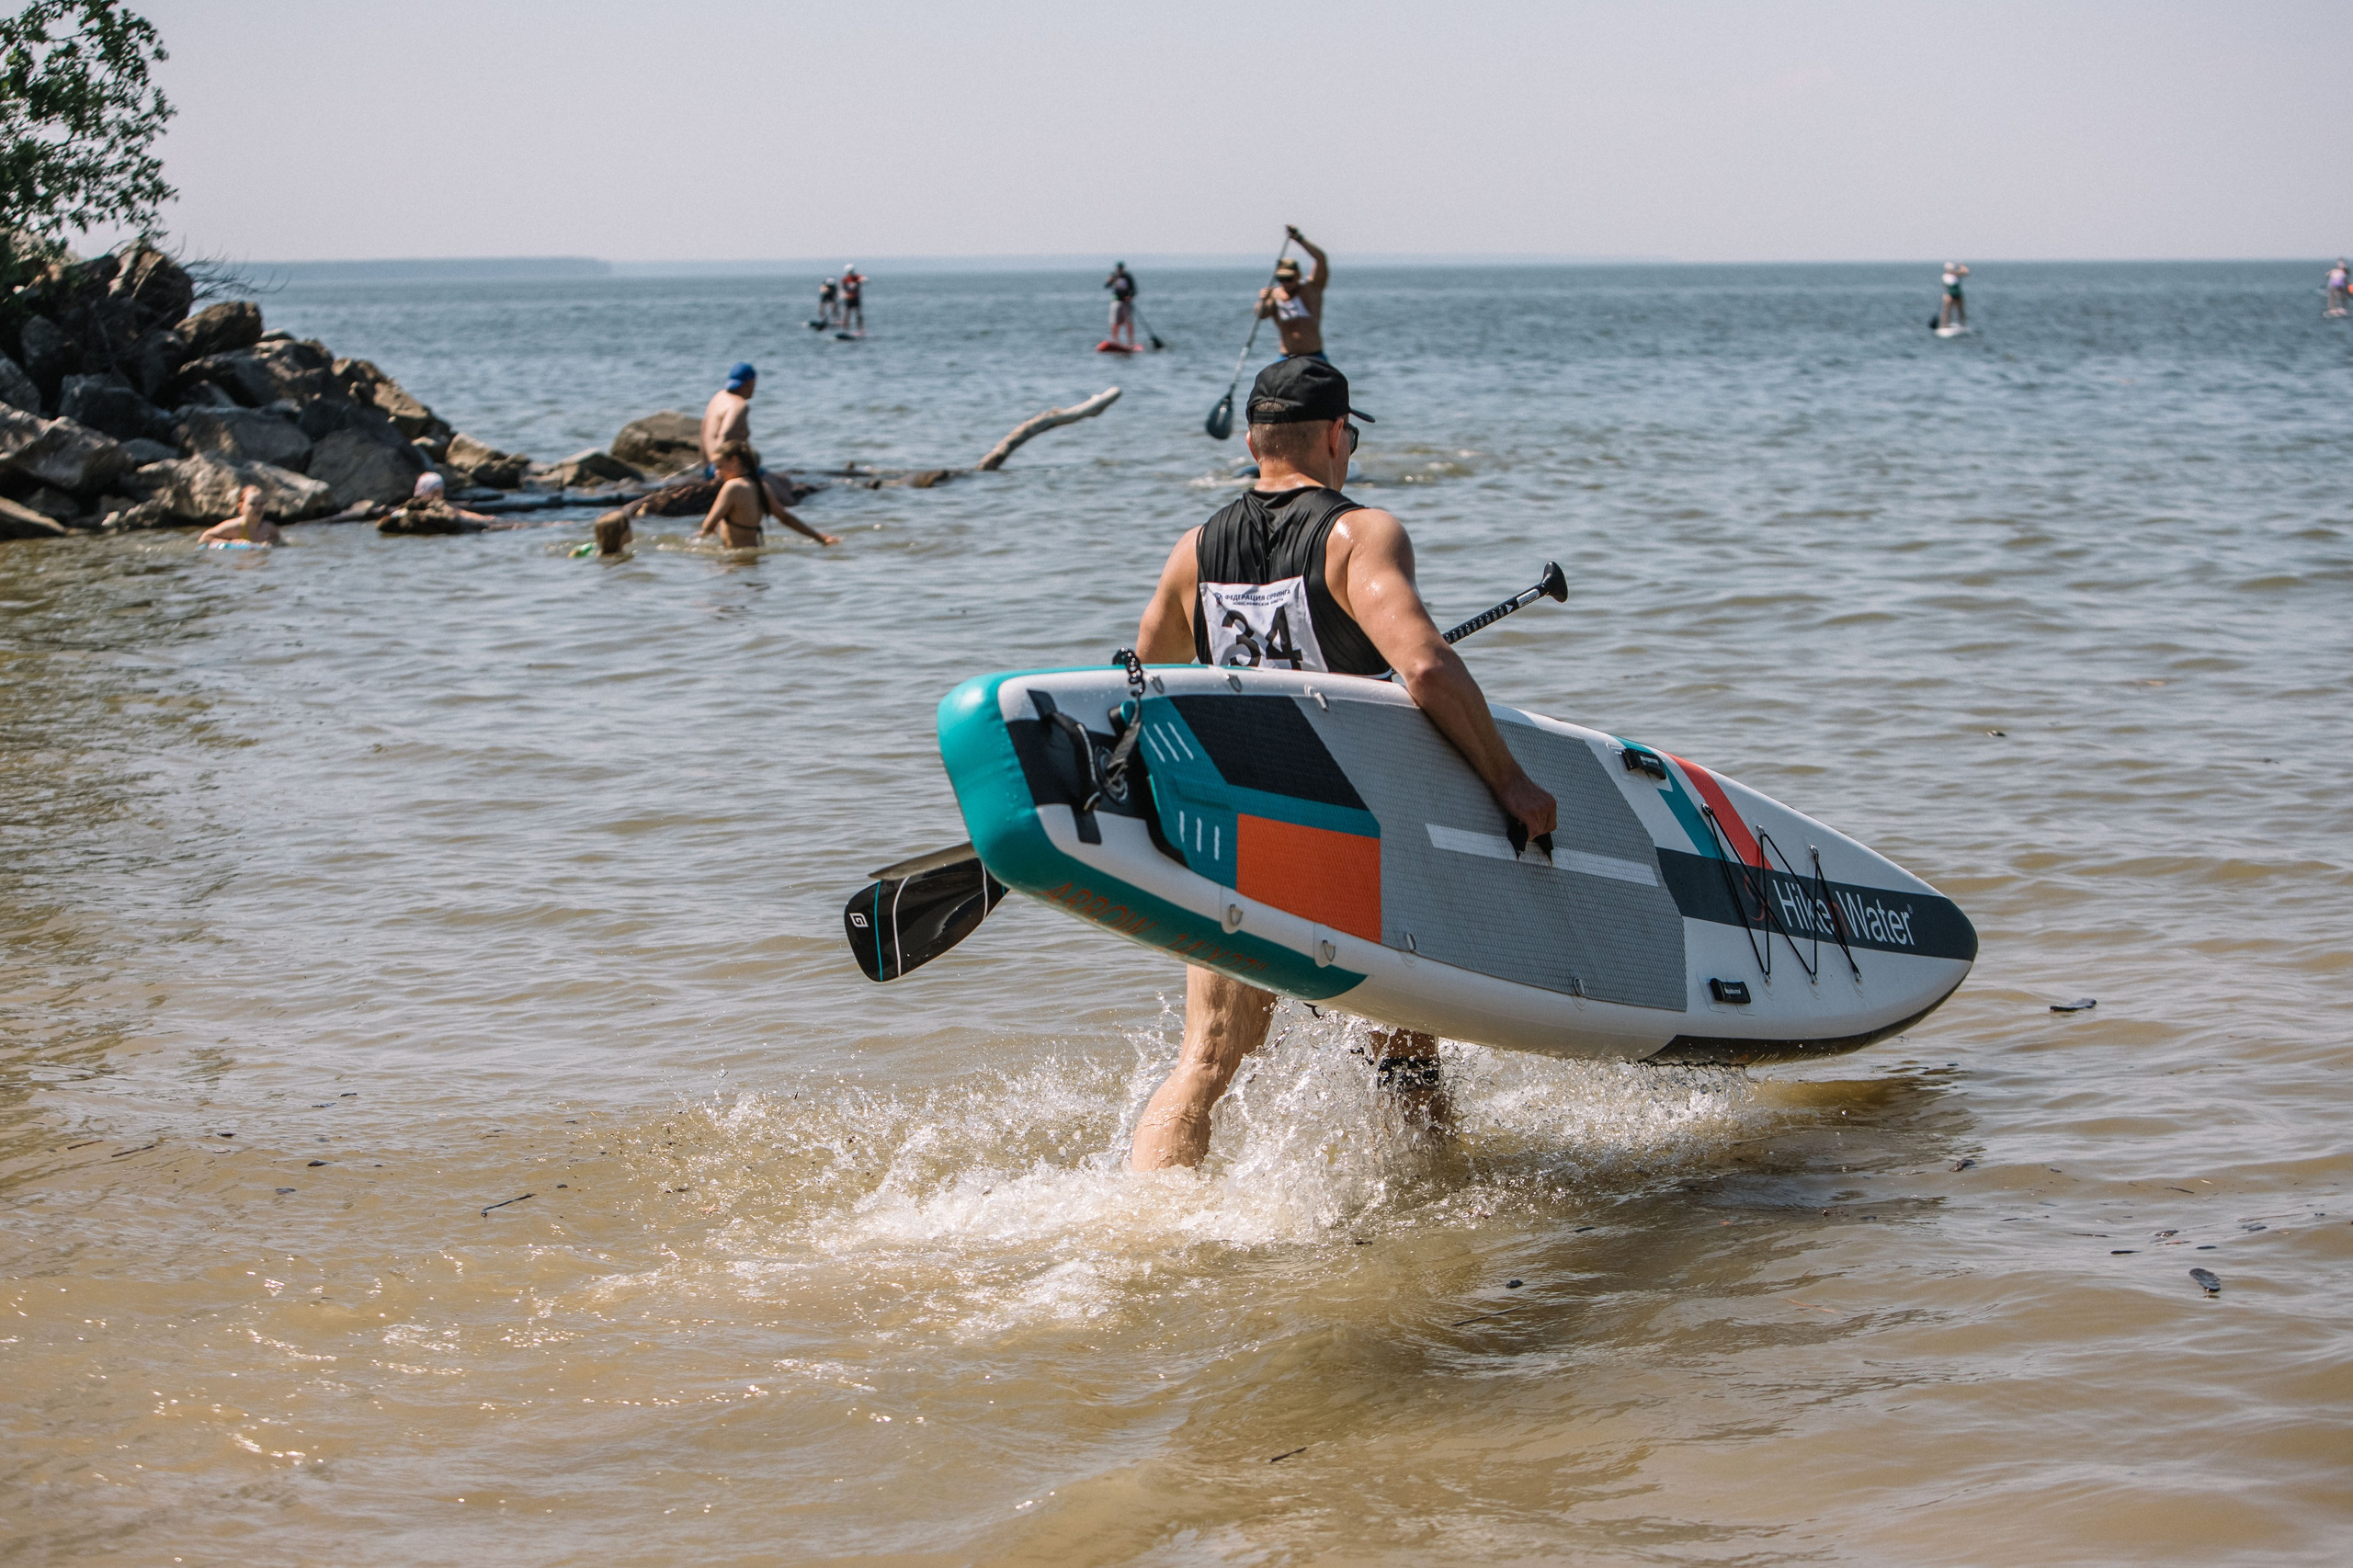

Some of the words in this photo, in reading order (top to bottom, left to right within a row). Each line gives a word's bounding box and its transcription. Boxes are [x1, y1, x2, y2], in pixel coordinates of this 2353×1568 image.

[1224, 594, 1266, 602] ФЕДЕРАЦИЯ
[1266, 588, 1291, 600] СРФИНГА
[1222, 606, 1303, 670] 34
[1032, 882, 1158, 936] ARROW
